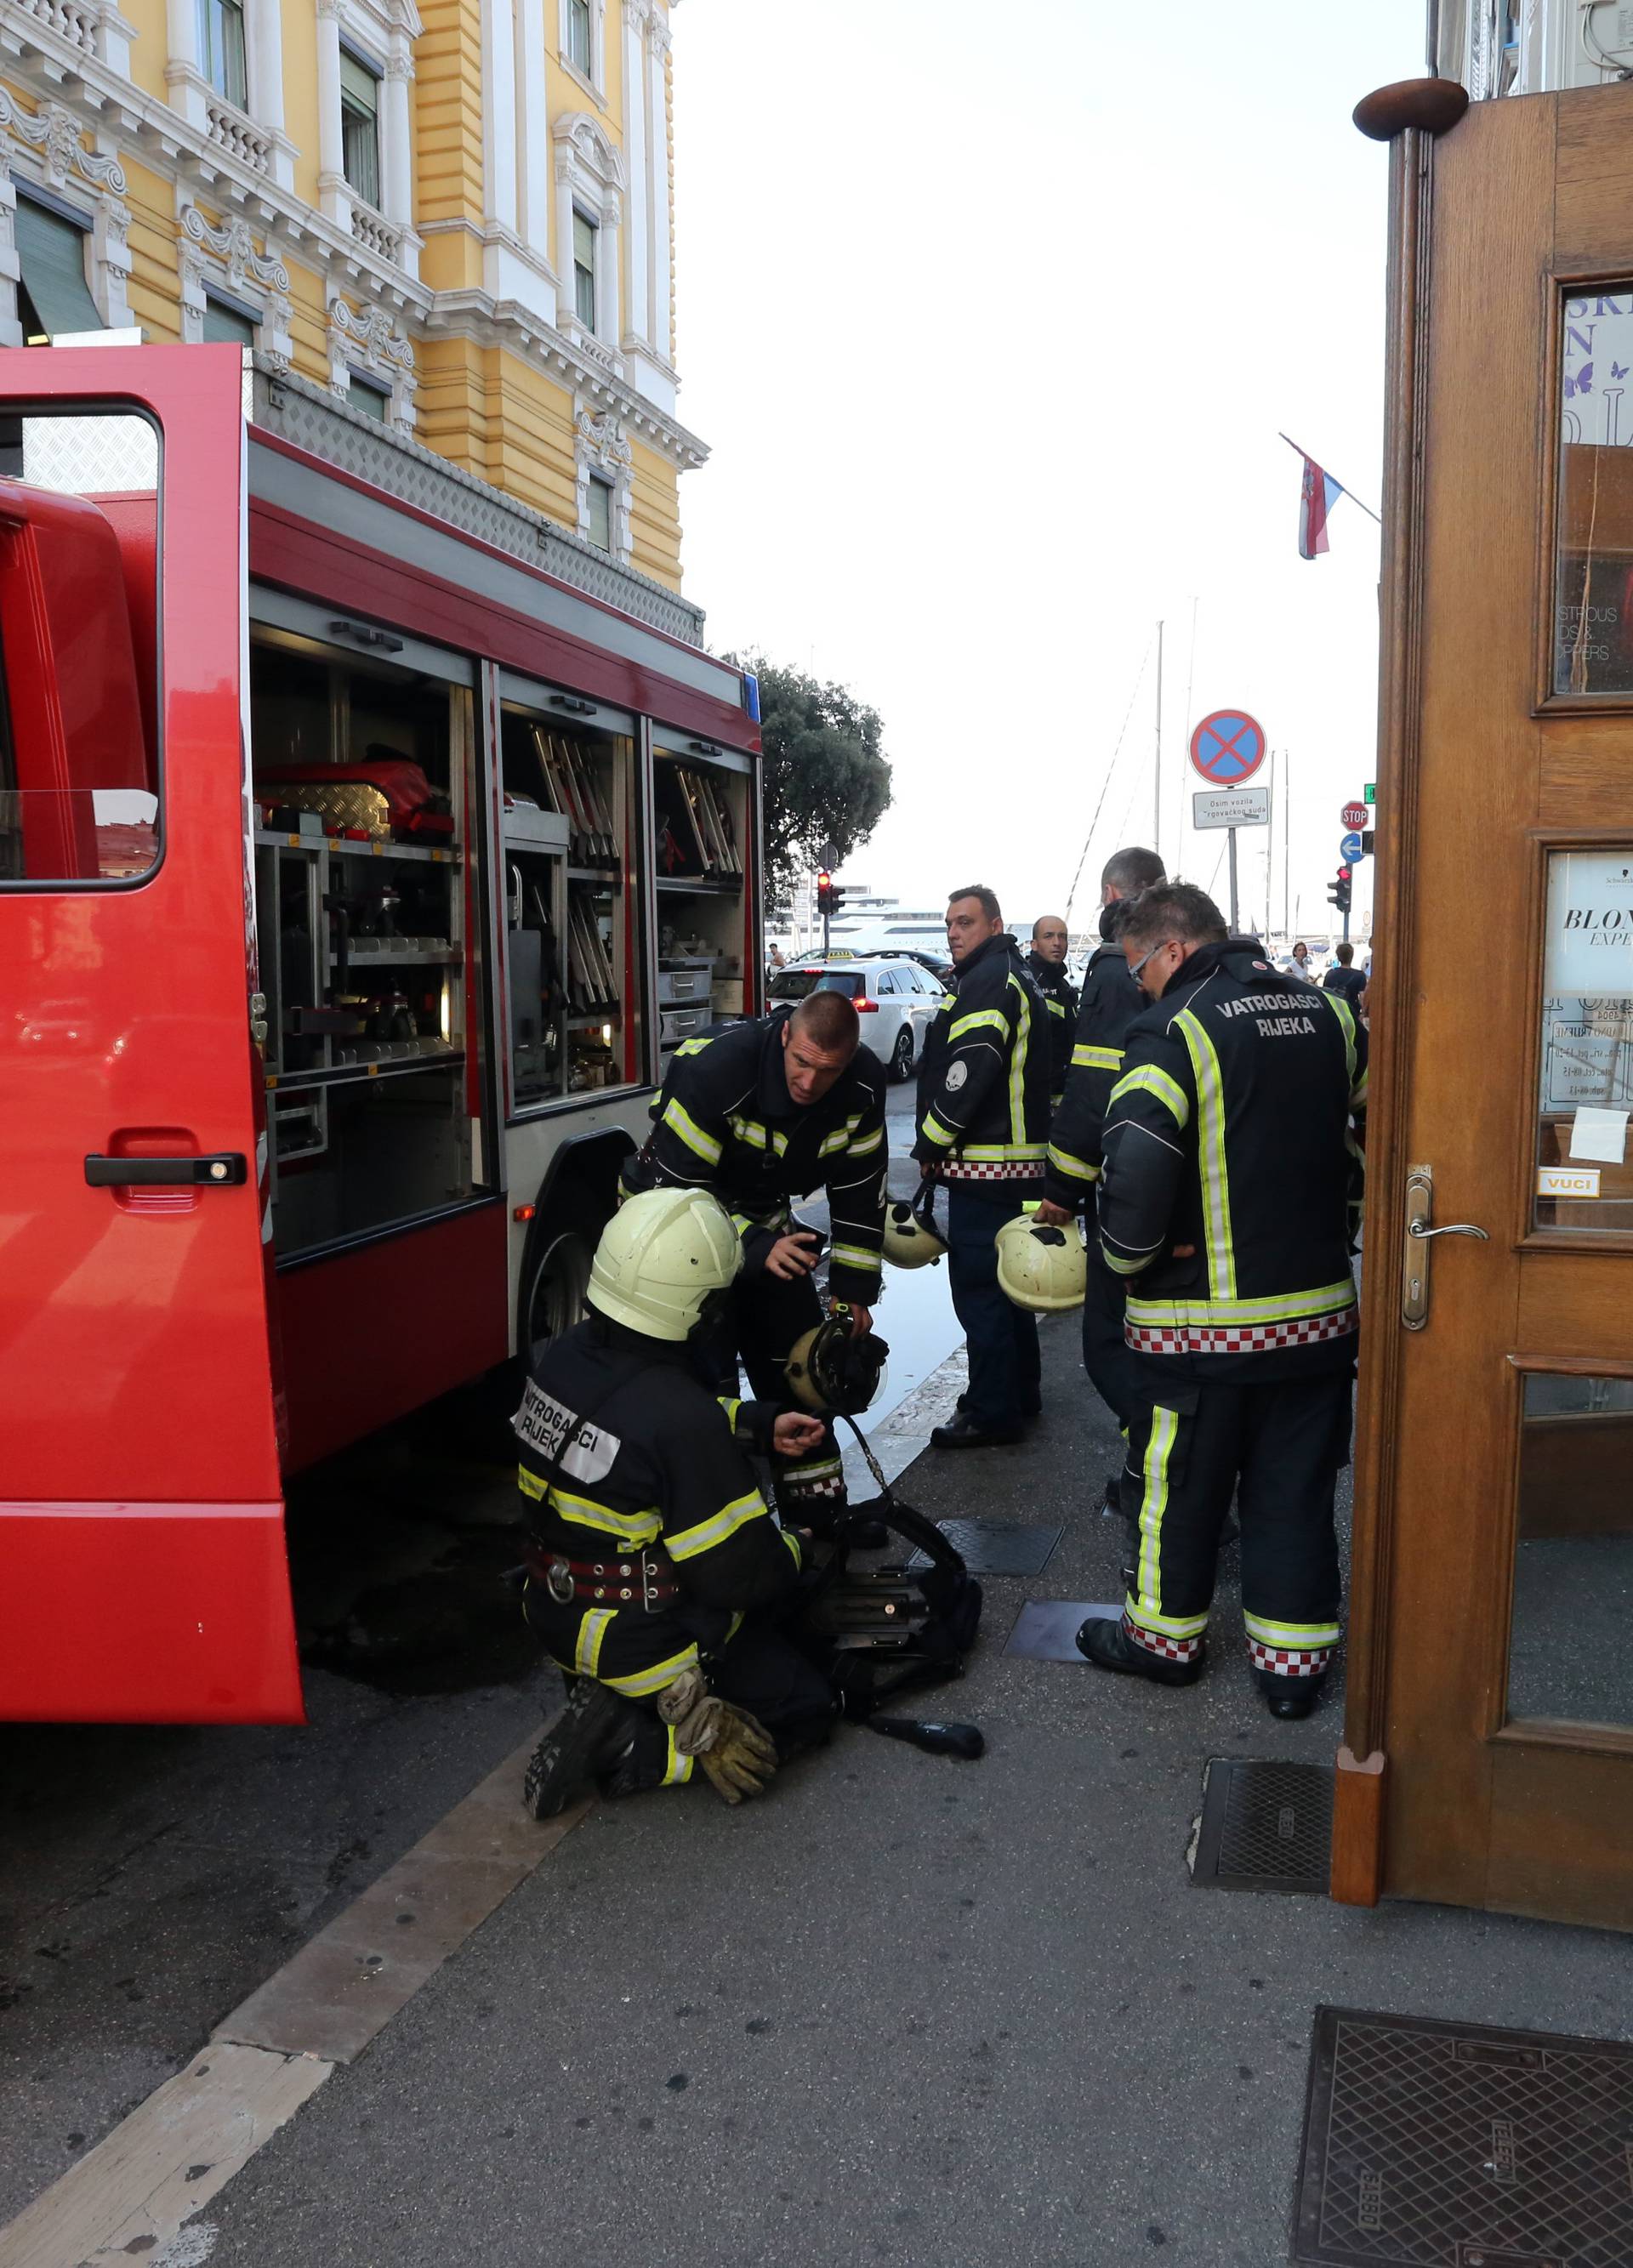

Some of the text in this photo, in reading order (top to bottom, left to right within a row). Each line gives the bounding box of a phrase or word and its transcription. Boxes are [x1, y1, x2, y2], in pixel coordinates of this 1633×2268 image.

[1232, 798, 1254, 806] vozila
[1203, 806, 1266, 818] rgovačkog suda
[1343, 810, 1367, 823] STOP
[1215, 994, 1324, 1019] VATROGASCI
[1255, 1016, 1317, 1037] RIJEKA
[1547, 1178, 1591, 1190] VUCI
[521, 1415, 560, 1454] RIJEK
